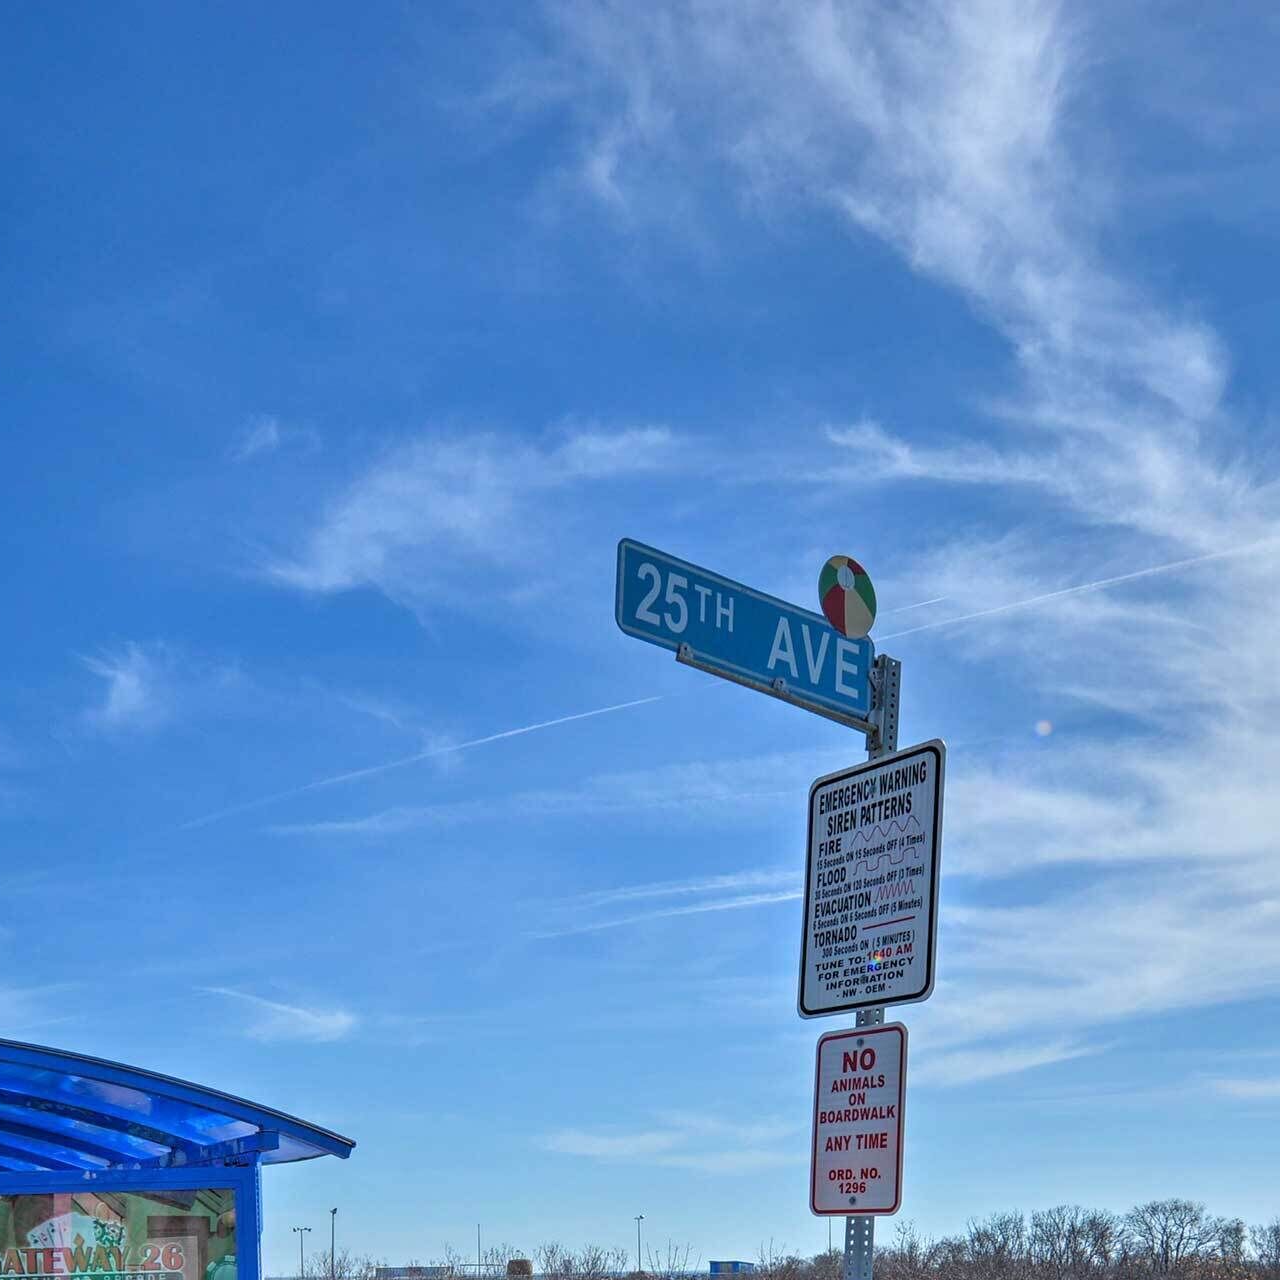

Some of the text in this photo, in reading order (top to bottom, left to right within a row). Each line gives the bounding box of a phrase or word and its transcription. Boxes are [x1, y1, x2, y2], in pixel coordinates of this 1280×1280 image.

[635, 562, 860, 699] 25TH AVE
[819, 761, 927, 815] EMERGENCY WARNING
[827, 792, 912, 837] SIREN PATTERNS
[819, 838, 841, 858] FIRE
[823, 857, 845, 869] Seconds
[846, 853, 854, 863] ON
[863, 844, 885, 857] Seconds
[887, 839, 897, 851] OFF
[906, 832, 925, 846] Times)
[817, 867, 846, 888] FLOOD
[822, 885, 843, 898] Seconds
[844, 883, 851, 893] ON
[863, 874, 885, 888] Seconds
[887, 871, 897, 882] OFF
[906, 864, 924, 877] Times)
[815, 891, 871, 919] EVACUATION
[818, 896, 922, 929] Seconds ON Seconds OFF Minutes)
[814, 925, 857, 949] TORNADO
[822, 931, 910, 959] 300 Seconds ON MINUTES
[816, 960, 844, 972] TUNE
[848, 956, 866, 966] TO:
[895, 943, 912, 956] AM
[818, 956, 914, 981] FOR EMERGENCY
[842, 983, 886, 998] NW OEM
[842, 1048, 876, 1073] NO
[831, 1075, 885, 1093] ANIMALS
[848, 1093, 866, 1106] ON
[820, 1105, 895, 1124] BOARDWALK
[825, 1133, 888, 1152] ANY TIME
[828, 1167, 881, 1181] ORD. NO.
[838, 1182, 866, 1194] 1296
[139, 1242, 186, 1272] 26
